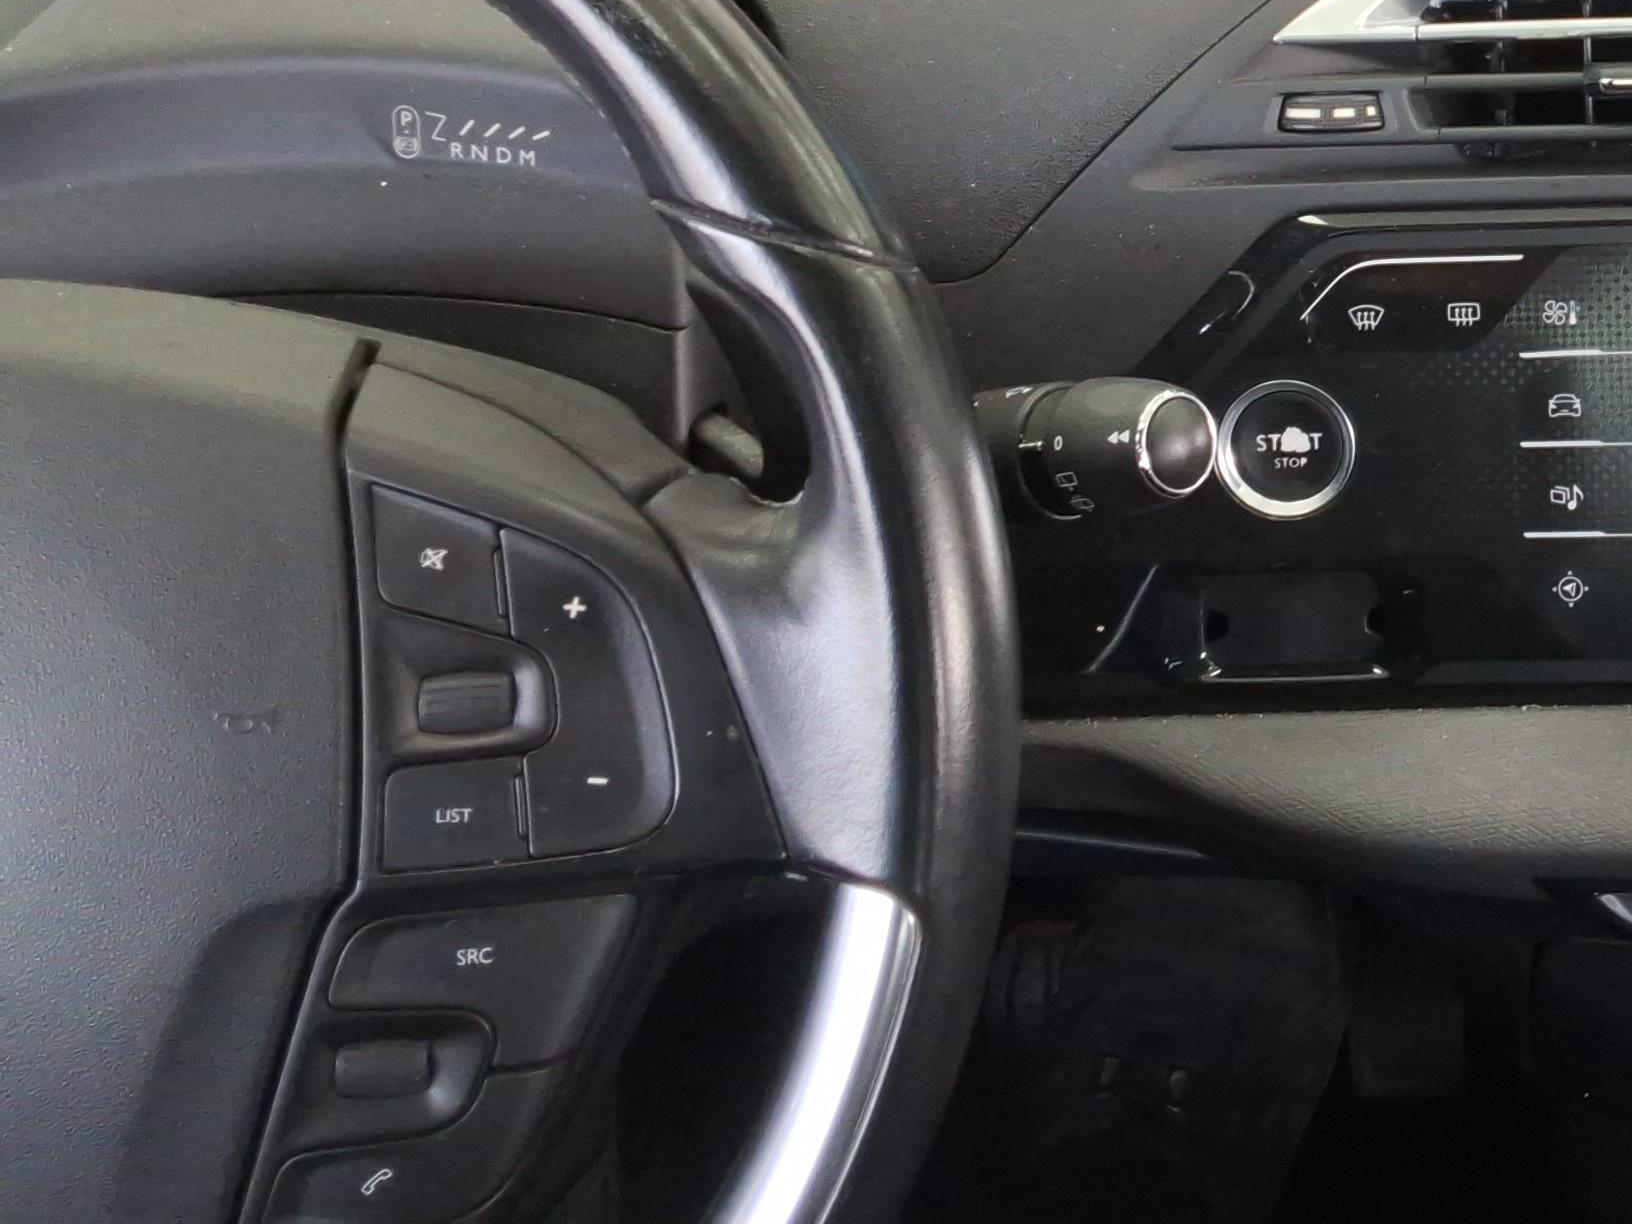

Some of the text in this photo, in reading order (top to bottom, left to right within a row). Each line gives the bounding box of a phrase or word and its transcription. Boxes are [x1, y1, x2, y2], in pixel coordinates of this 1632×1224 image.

[1256, 432, 1322, 451] STT
[1274, 457, 1308, 469] STOP
[436, 808, 471, 824] LIST
[456, 949, 493, 966] SRC
